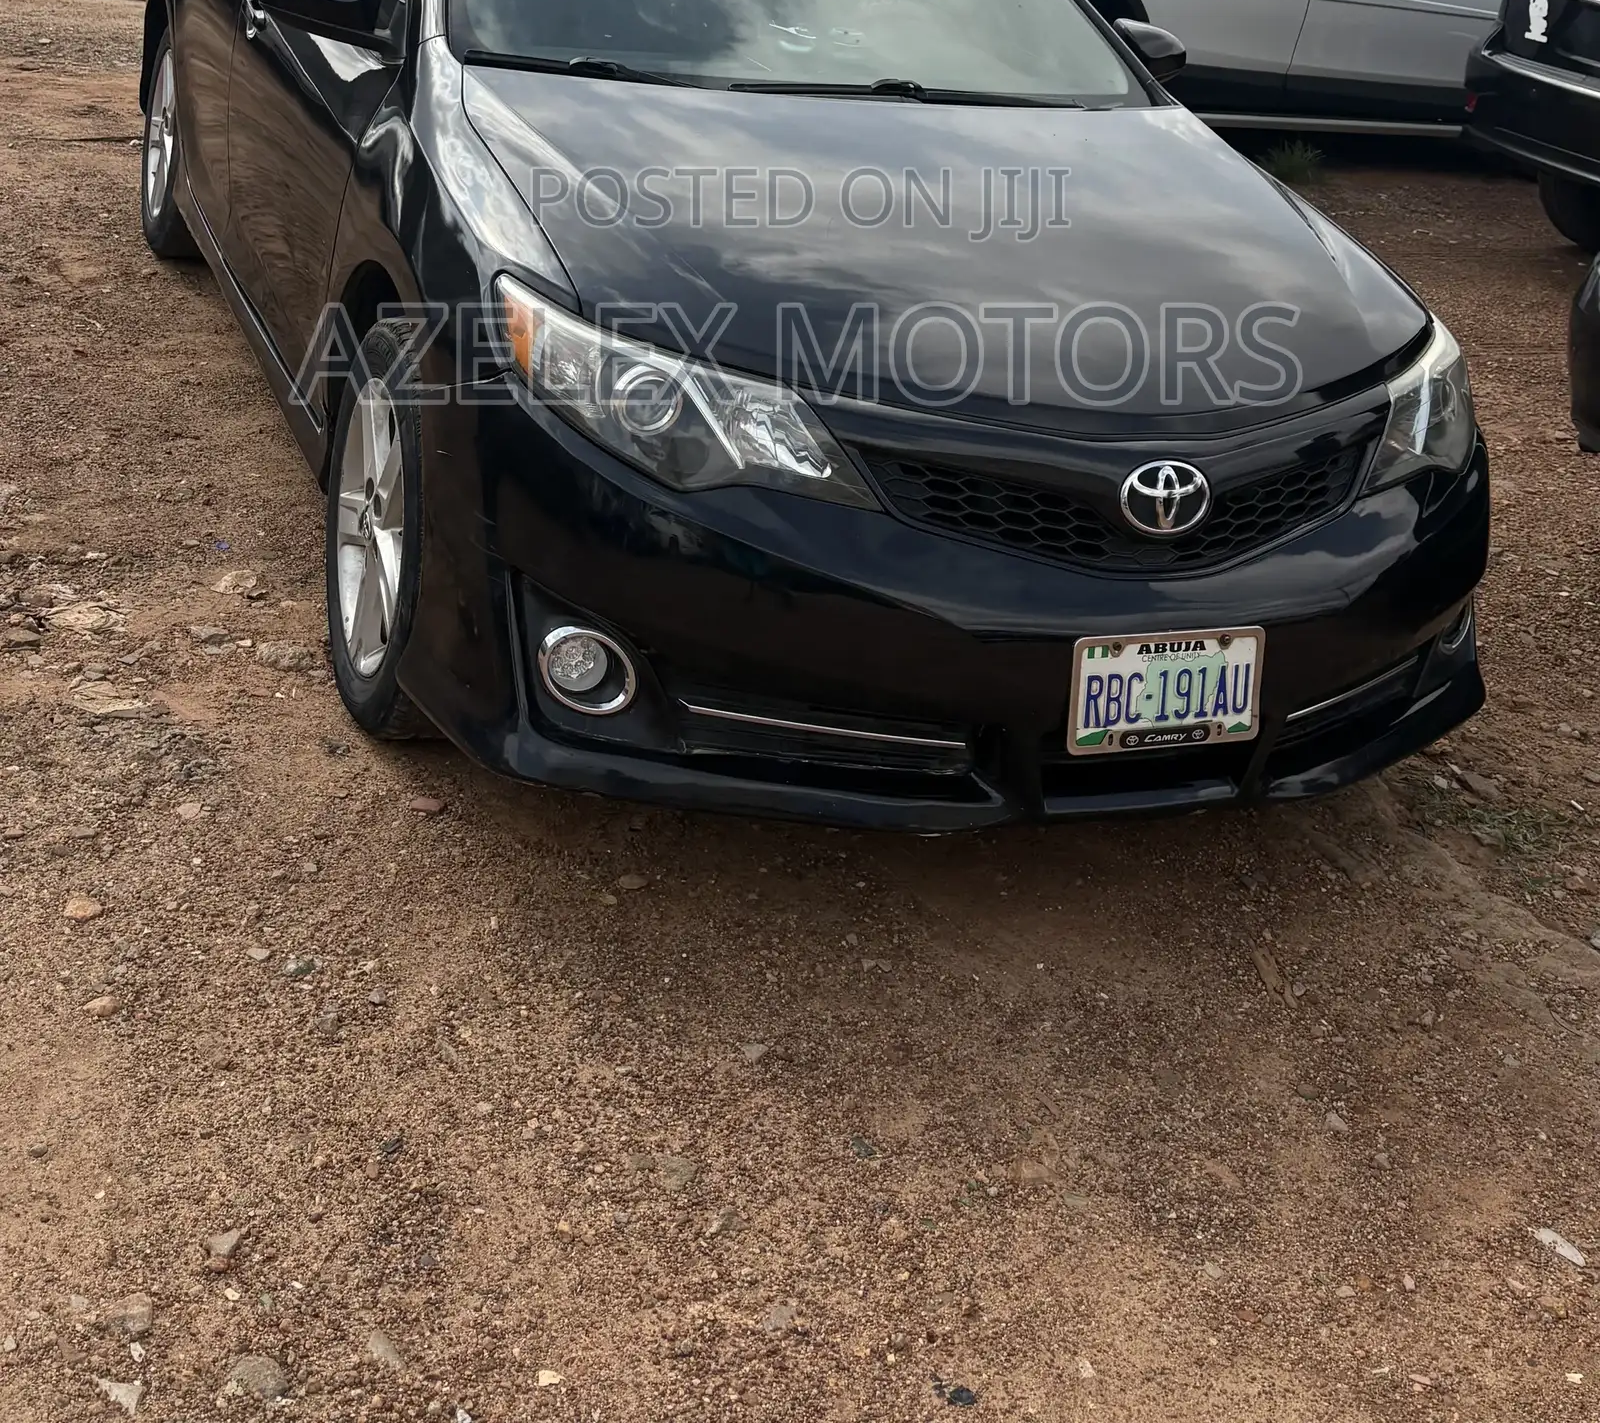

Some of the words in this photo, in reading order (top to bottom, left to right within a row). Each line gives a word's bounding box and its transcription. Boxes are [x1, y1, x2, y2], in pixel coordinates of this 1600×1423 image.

[1137, 640, 1207, 655] ABUJA
[1141, 653, 1169, 663] CENTRE
[1083, 663, 1251, 728] RBC-191AU
[1144, 733, 1188, 742] CAMRY
